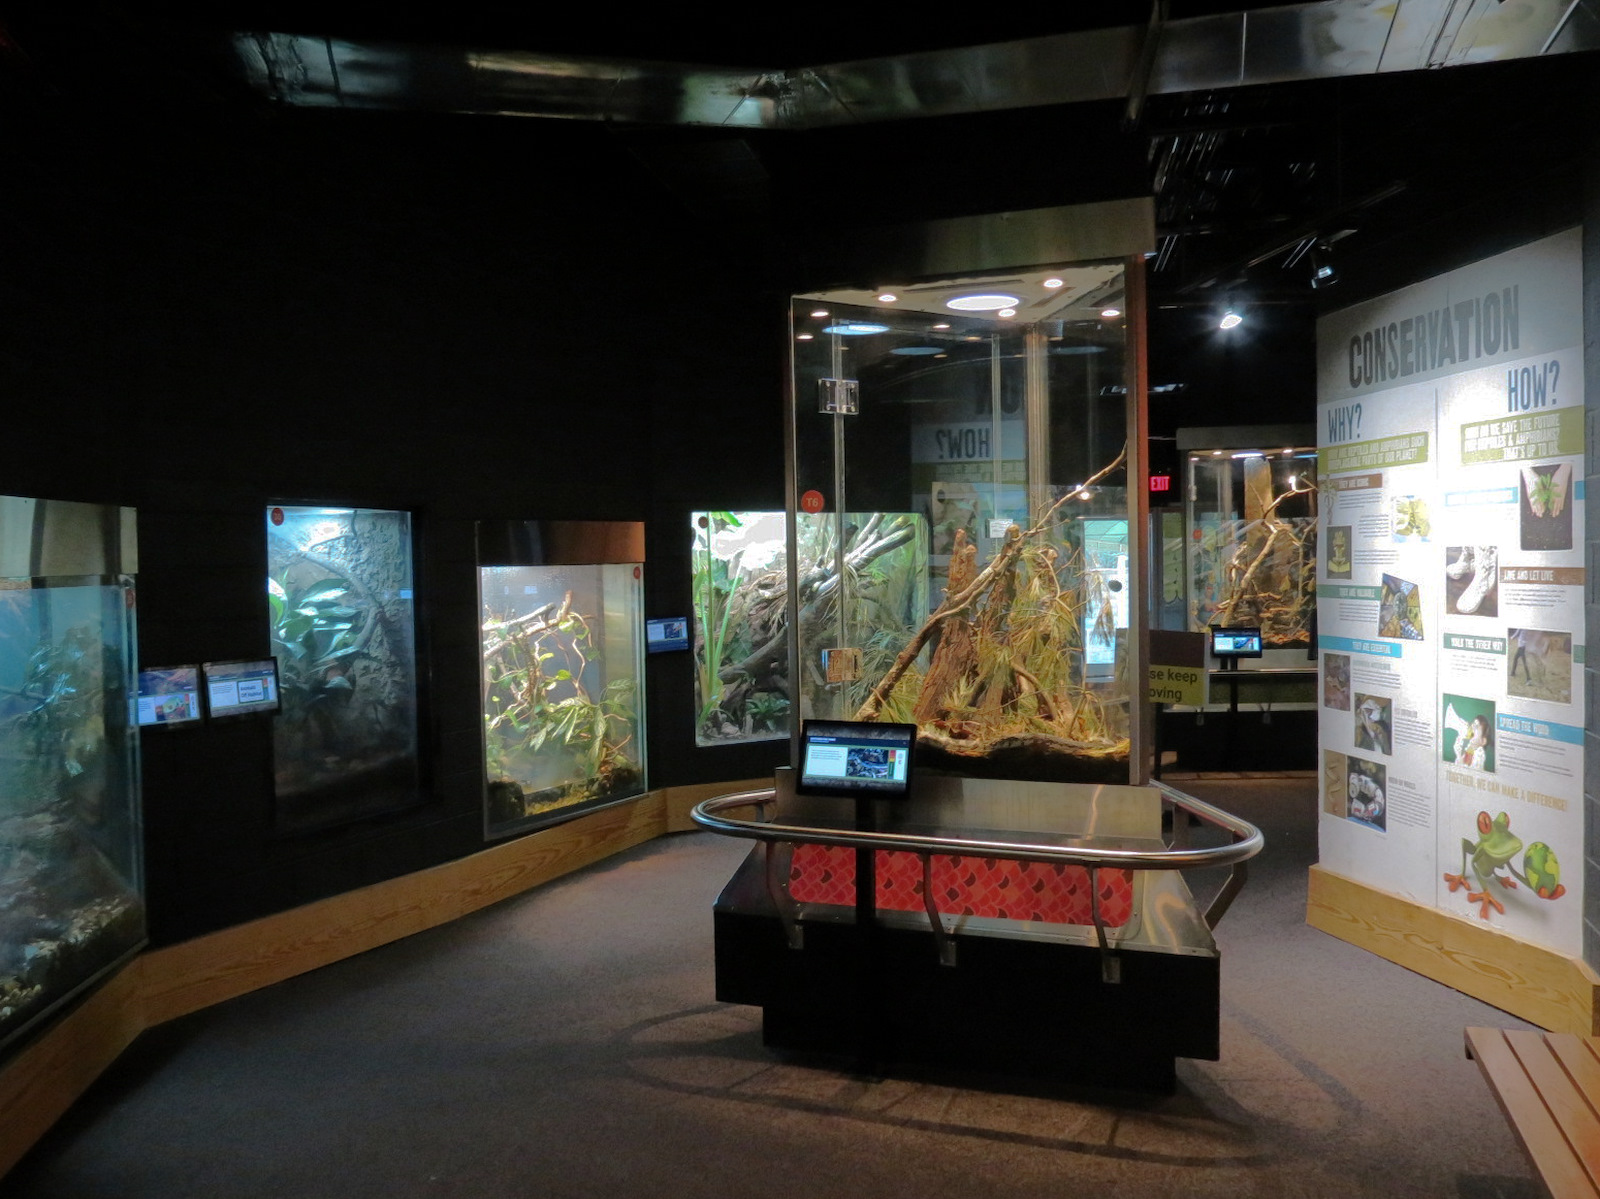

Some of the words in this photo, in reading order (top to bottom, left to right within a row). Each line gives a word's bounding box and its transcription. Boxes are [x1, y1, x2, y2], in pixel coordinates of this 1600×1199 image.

[1349, 284, 1520, 389] CONSERVATION
[1507, 360, 1561, 413] HOW?
[1327, 403, 1363, 443] WHY?
[1150, 476, 1170, 491] EXIT
[1529, 570, 1539, 581] LET
[1540, 570, 1554, 582] LIVE
[1167, 668, 1198, 685] keep
